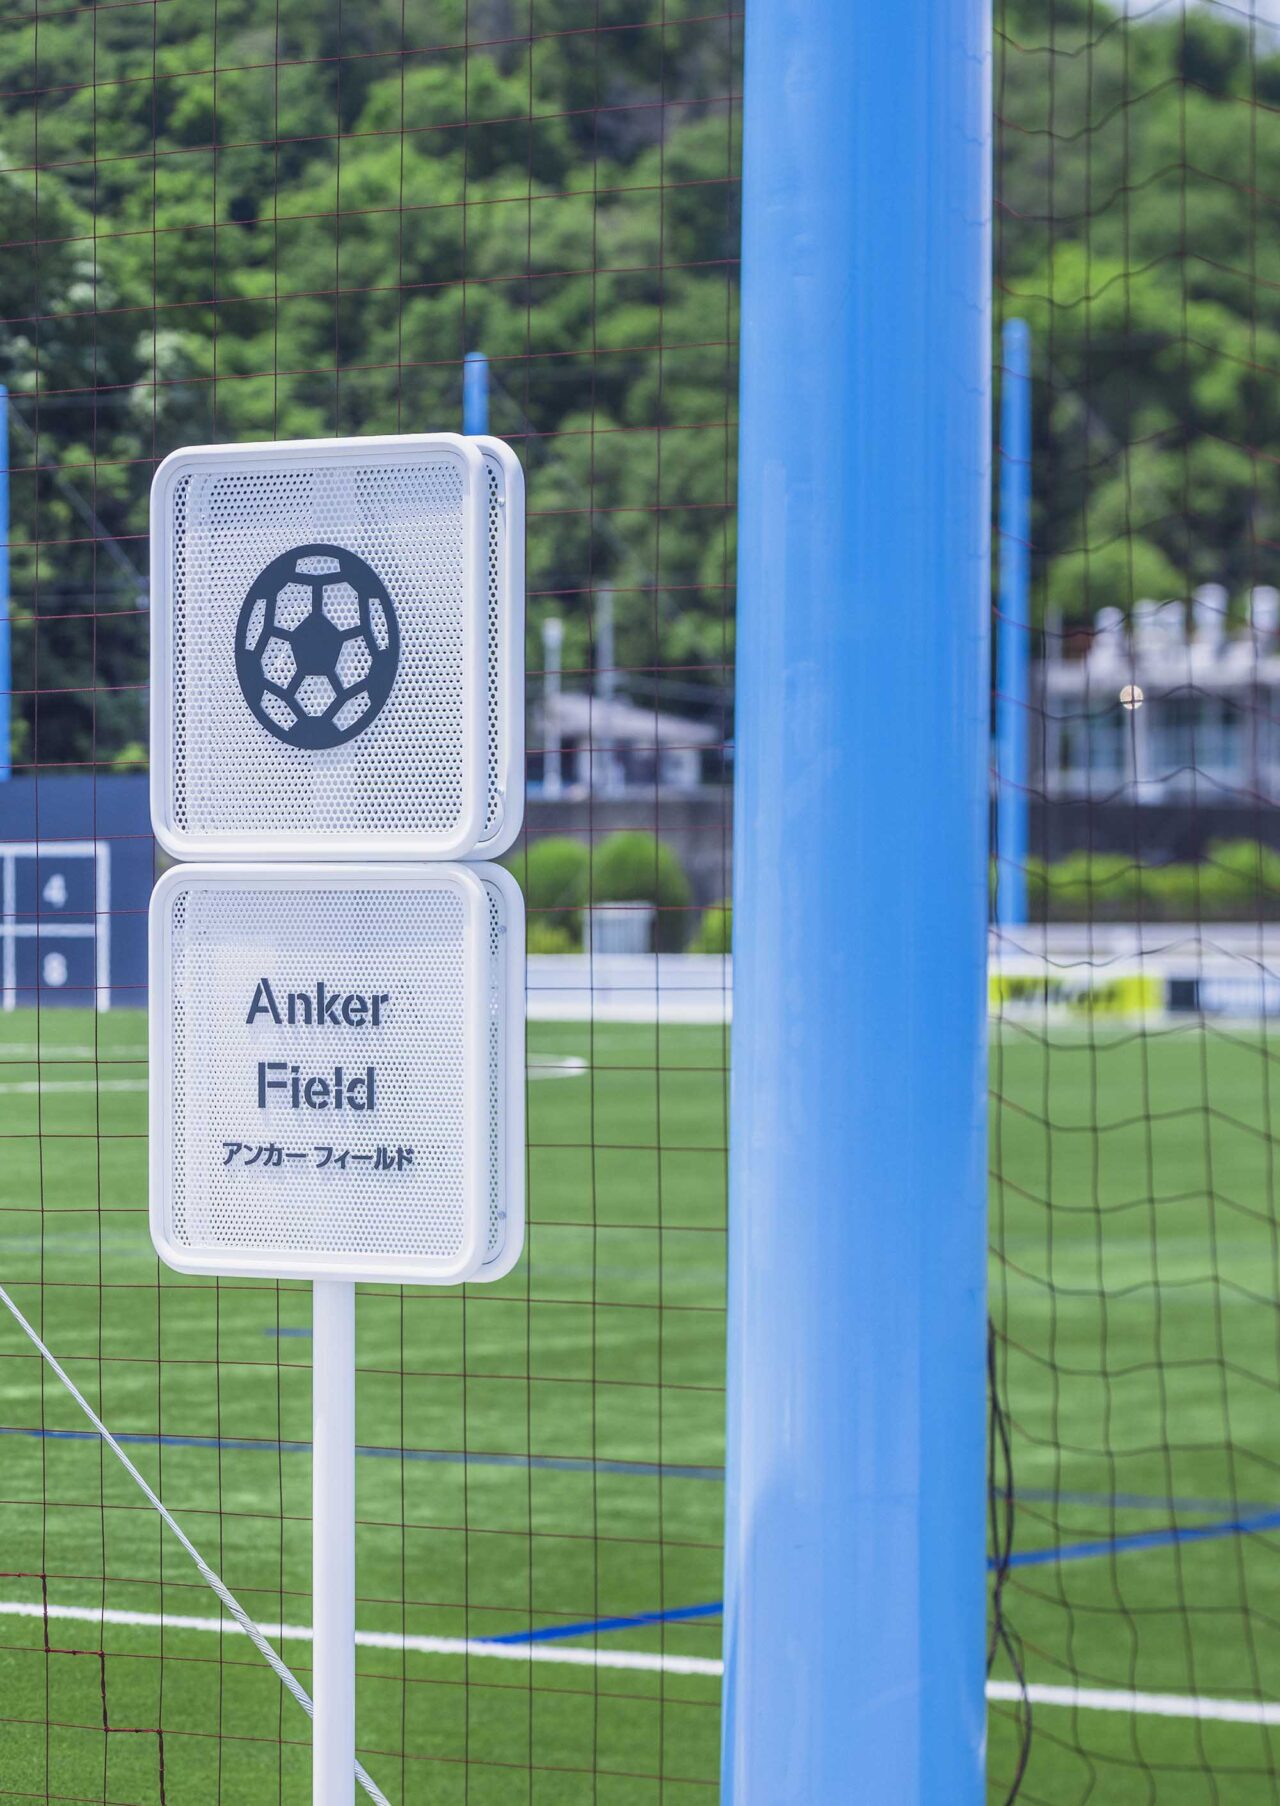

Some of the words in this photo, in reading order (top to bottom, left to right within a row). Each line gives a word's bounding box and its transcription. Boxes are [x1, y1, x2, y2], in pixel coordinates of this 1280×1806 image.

[43, 873, 68, 908] 4
[43, 952, 68, 987] 8
[245, 977, 389, 1027] Anker
[257, 1061, 376, 1111] Field
[222, 1141, 308, 1167] アンカー
[314, 1145, 416, 1172] フィールド
